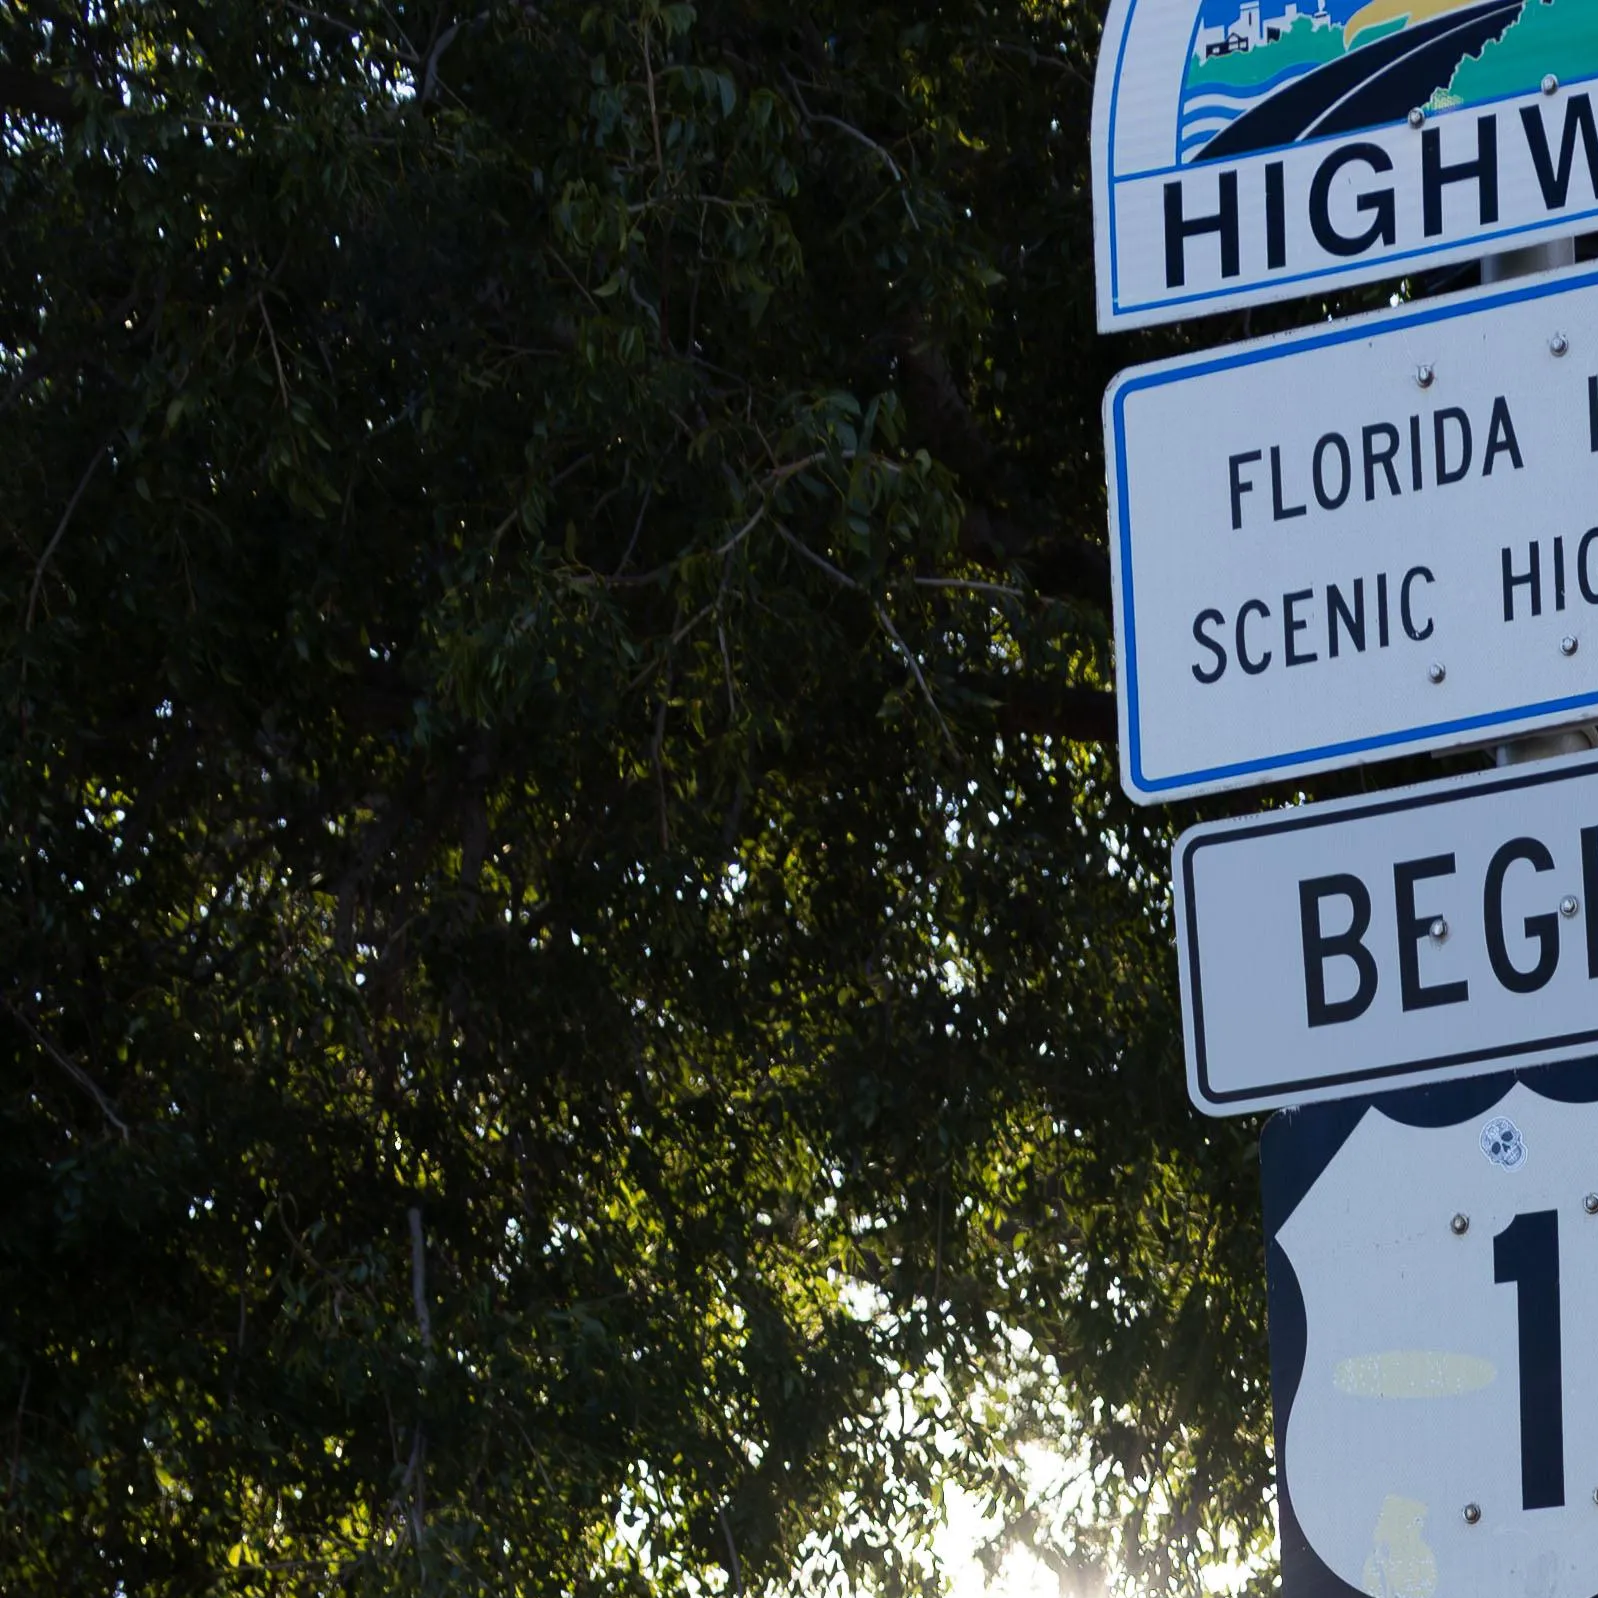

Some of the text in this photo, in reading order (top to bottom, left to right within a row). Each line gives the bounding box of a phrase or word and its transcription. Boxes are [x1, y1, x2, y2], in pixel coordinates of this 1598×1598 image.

[1228, 395, 1524, 530] FLORIDA
[1190, 565, 1437, 684] SCENIC
[1492, 1208, 1567, 1511] 1
